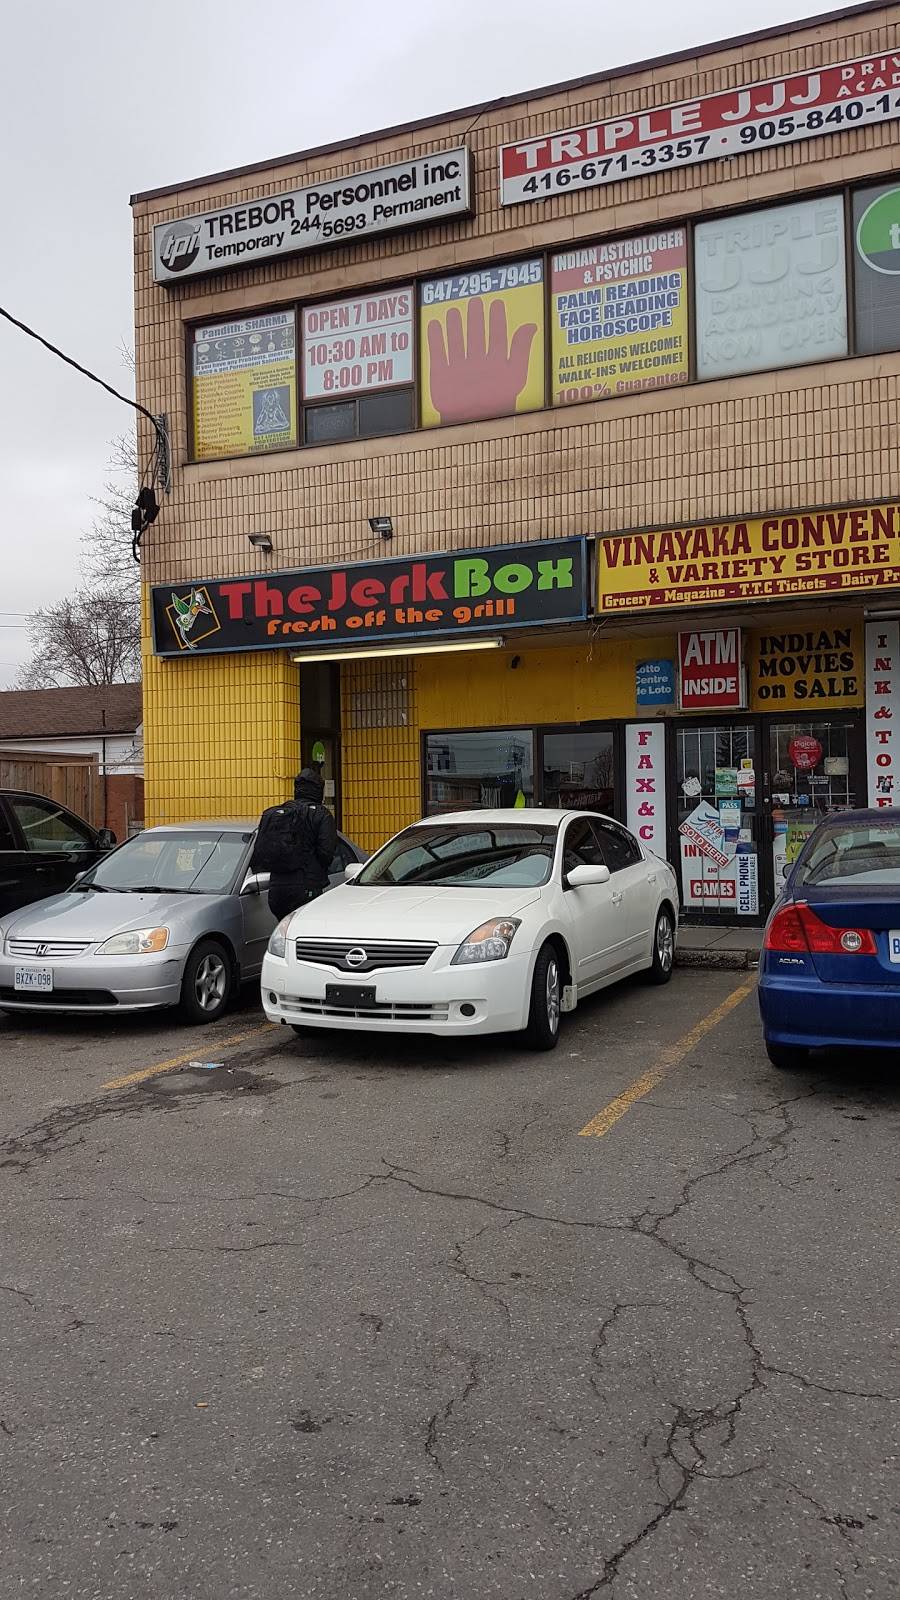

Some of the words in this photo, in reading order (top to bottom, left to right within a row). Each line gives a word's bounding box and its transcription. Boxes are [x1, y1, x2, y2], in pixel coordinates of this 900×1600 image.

[515, 103, 702, 169] TRIPLE
[721, 75, 821, 121] JJJ
[522, 135, 711, 194] 416-671-3357
[205, 198, 295, 238] TREBOR
[306, 167, 417, 214] Personnel
[205, 232, 286, 260] Temporary
[290, 214, 321, 236] 244
[322, 213, 366, 238] 5693
[373, 186, 461, 221] Permanent
[553, 252, 597, 273] INDIAN
[600, 230, 684, 262] ASTROLOGER
[423, 261, 542, 304] 647-295-7945
[583, 270, 594, 285] &
[595, 255, 653, 281] PSYCHIC
[556, 289, 602, 313] PALM
[605, 272, 683, 299] READING
[245, 314, 288, 331] SHARMA
[308, 306, 350, 334] OPEN
[353, 303, 363, 327] 7
[366, 294, 409, 322] DAYS
[559, 306, 600, 328] FACE
[602, 292, 680, 318] READING
[566, 309, 672, 345] HOROSCOPE
[308, 339, 356, 367] 10:30
[359, 333, 387, 359] AM
[391, 331, 409, 352] to
[558, 355, 575, 370] ALL
[576, 346, 628, 367] RELIGIONS
[629, 336, 682, 359] WELCOME!
[323, 363, 362, 391] 8:00
[366, 358, 394, 384] PM
[558, 363, 617, 384] WALK-INS
[619, 352, 683, 375] WELCOME!
[556, 380, 612, 402] 100%
[615, 371, 689, 392] Guarantee
[603, 523, 751, 568] VINAYAKA
[762, 507, 900, 553] CONVEN
[649, 567, 660, 585] &
[667, 555, 786, 584] VARIETY
[795, 544, 890, 573] STORE
[605, 594, 651, 608] Grocery
[664, 587, 725, 603] Magazine
[779, 579, 826, 593] Tickets
[841, 572, 879, 586] Dairy
[345, 608, 385, 630] off
[395, 606, 443, 625] the
[452, 598, 515, 624] grill
[684, 632, 736, 666] ATM
[761, 629, 851, 656] INDIAN
[758, 652, 854, 678] MOVIES
[648, 685, 672, 695] Loto
[684, 677, 736, 695] INSIDE
[758, 681, 786, 700] on
[794, 677, 858, 699] SALE
[682, 824, 704, 846] SOLD
[703, 842, 728, 866] HERE
[739, 856, 750, 887] PHONE
[693, 882, 735, 897] GAMES
[739, 890, 751, 913] CELL
